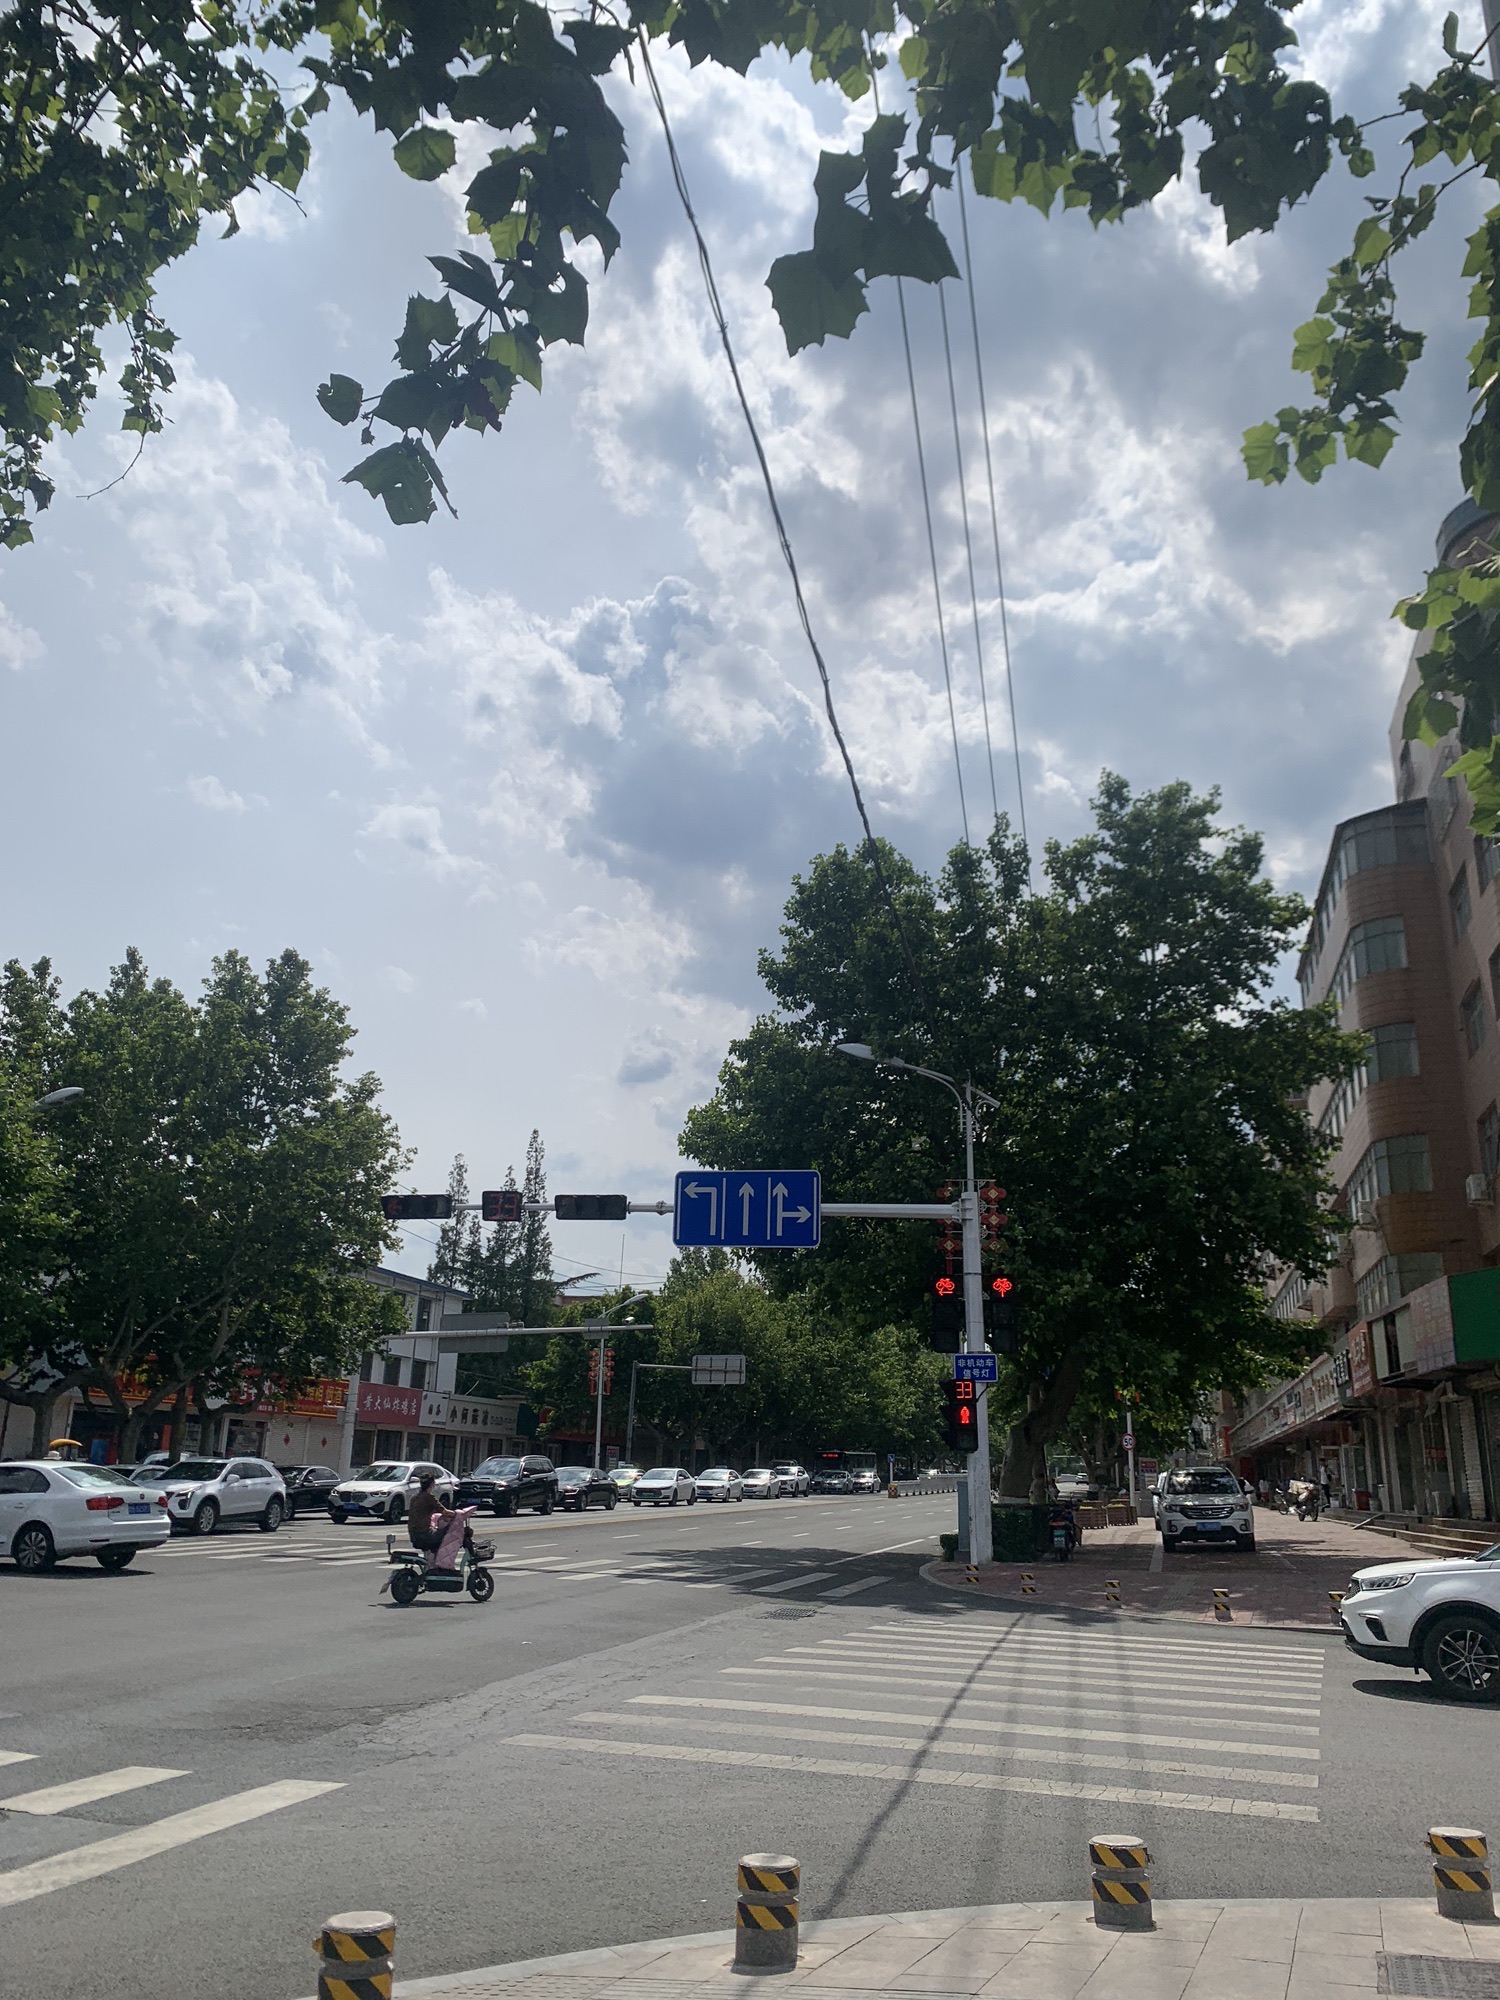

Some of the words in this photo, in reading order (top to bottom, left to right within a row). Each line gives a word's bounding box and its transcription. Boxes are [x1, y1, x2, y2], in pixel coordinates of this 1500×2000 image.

[488, 1193, 517, 1219] 33
[957, 1358, 994, 1368] 非机动车
[963, 1368, 990, 1379] 信号灯
[955, 1381, 973, 1399] 33
[363, 1392, 418, 1416] 黄大仙炸鸡店
[1124, 1438, 1133, 1447] 50
